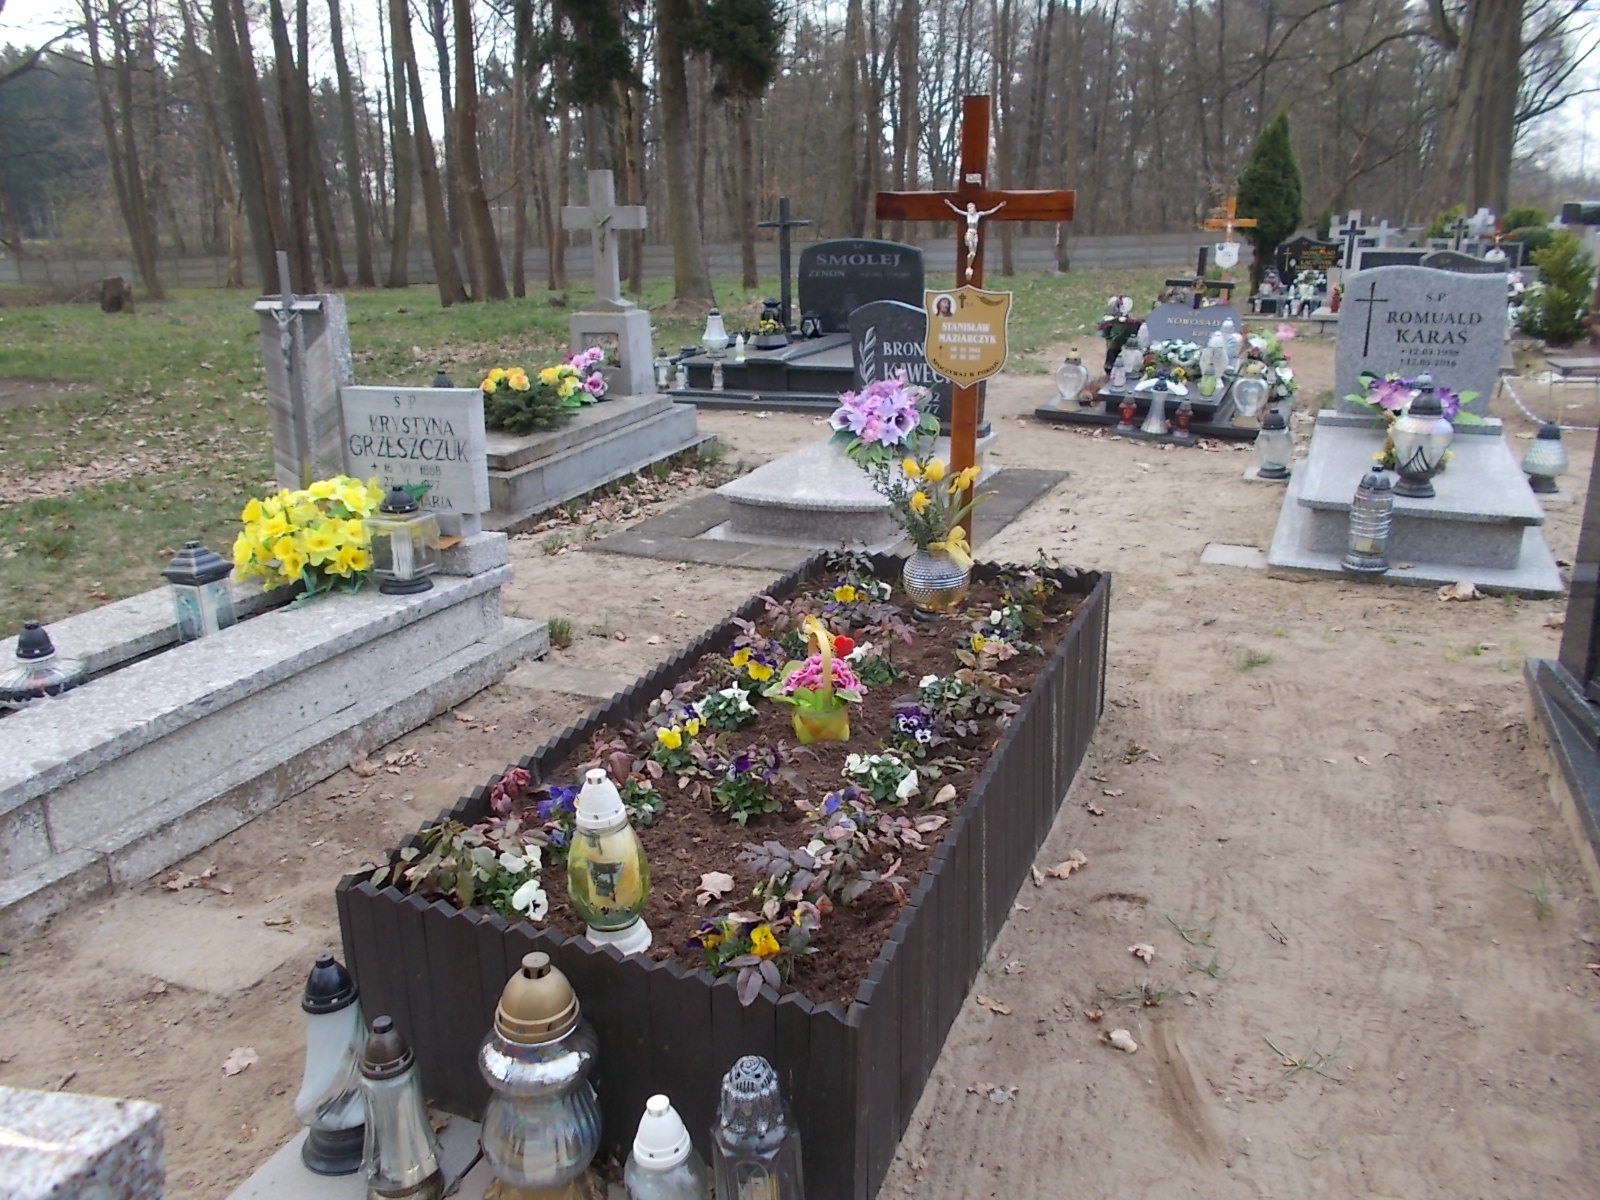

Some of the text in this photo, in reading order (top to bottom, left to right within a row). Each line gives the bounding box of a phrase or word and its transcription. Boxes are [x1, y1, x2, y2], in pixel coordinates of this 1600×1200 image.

[816, 254, 901, 267] SMOLEJ
[1167, 317, 1220, 326] NOWOSAD
[1387, 311, 1482, 325] ROMUALD
[942, 322, 990, 332] STANISŁAW
[938, 333, 996, 344] MAZIARCZYK
[883, 341, 924, 356] BRON
[884, 362, 951, 384] KAWEC
[369, 414, 454, 436] KRYSTYNA
[350, 434, 469, 462] GRZESZCZUK
